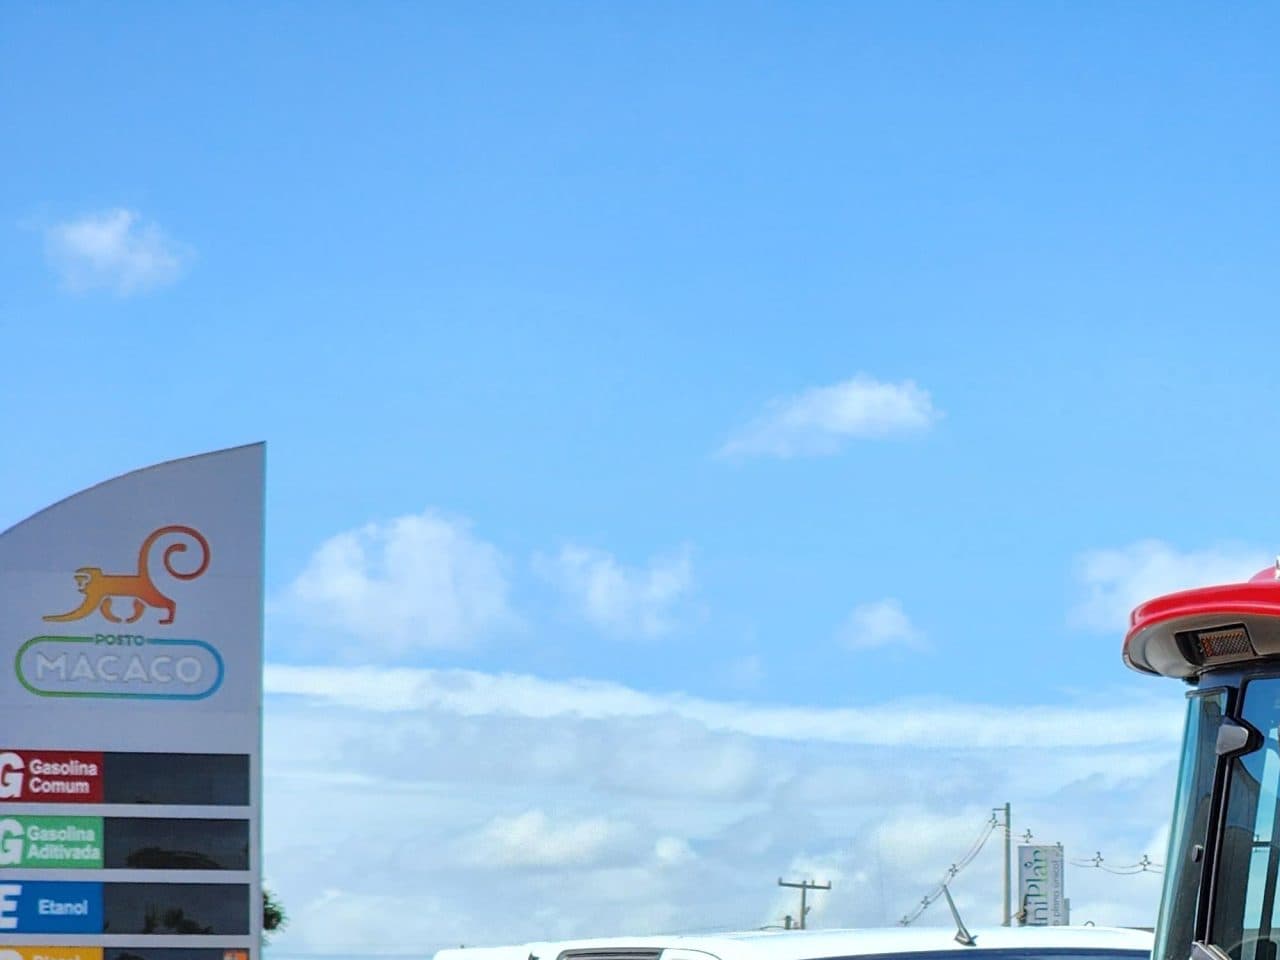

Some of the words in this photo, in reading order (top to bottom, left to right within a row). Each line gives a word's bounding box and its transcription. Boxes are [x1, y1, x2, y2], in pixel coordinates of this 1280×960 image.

[95, 634, 145, 646] POSTO
[36, 652, 203, 684] MACACO
[0, 752, 25, 798] G
[29, 759, 98, 776] Gasolina
[29, 777, 90, 793] Comum
[27, 825, 96, 841] Gasolina
[0, 819, 25, 865] G
[27, 844, 101, 860] Aditivada
[0, 884, 22, 929] E
[38, 899, 88, 915] Etanol
